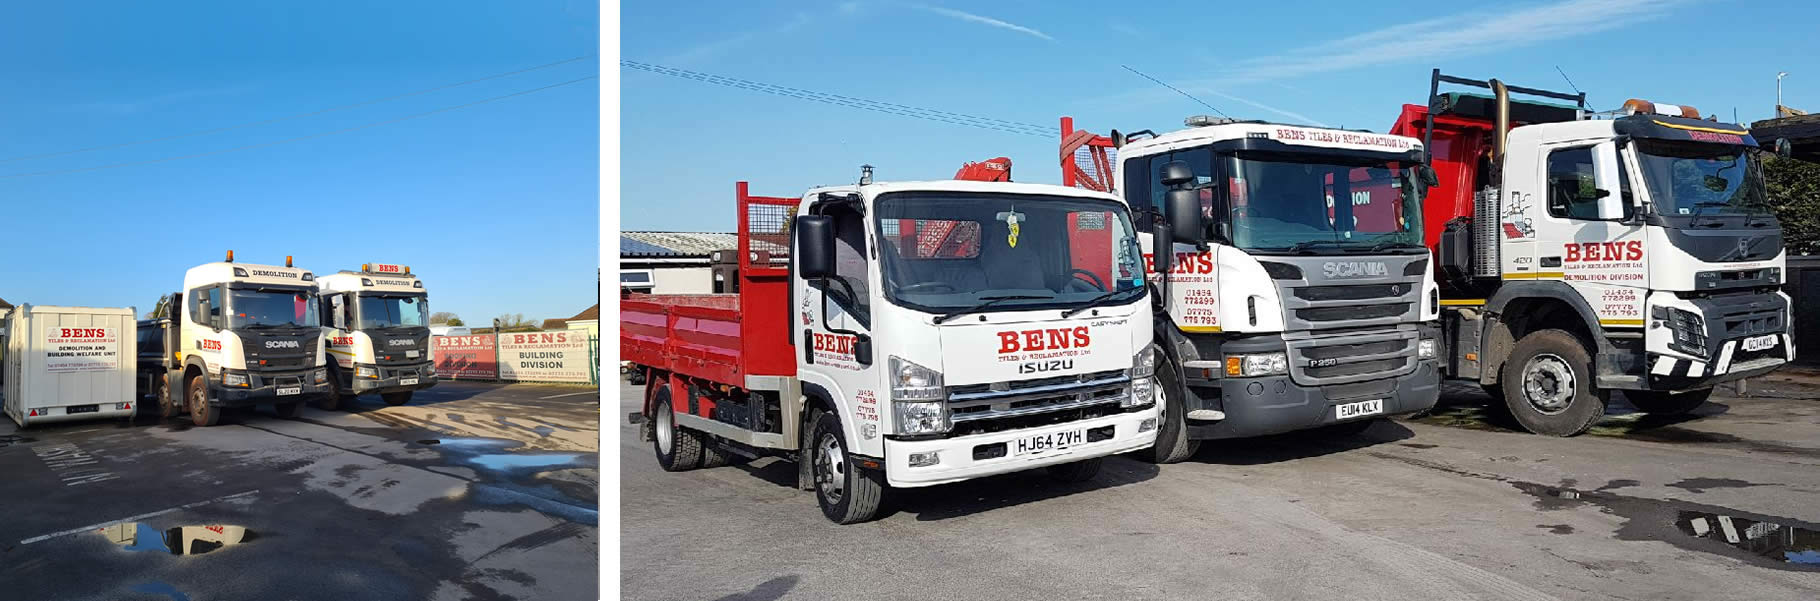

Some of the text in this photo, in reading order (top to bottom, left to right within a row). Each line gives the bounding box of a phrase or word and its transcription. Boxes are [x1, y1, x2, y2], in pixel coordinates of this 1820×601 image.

[1276, 129, 1305, 140] BENS
[1563, 240, 1643, 262] BENS
[378, 264, 399, 273] BENS
[1323, 261, 1389, 276] SCANIA
[252, 270, 297, 279] DEMOLITION
[1609, 273, 1644, 281] DIVISION
[1200, 316, 1217, 325] 793
[60, 328, 105, 338] BENS
[333, 336, 354, 345] BENS
[388, 338, 415, 346] SCANIA
[440, 336, 480, 346] BENS
[514, 333, 567, 344] BENS
[997, 325, 1090, 354] BENS
[203, 338, 222, 351] BENS
[265, 340, 300, 349] SCANIA
[519, 351, 564, 359] BUILDING
[520, 361, 563, 369] DIVISION
[1018, 359, 1074, 374] ISUZU
[1341, 400, 1379, 416] EU14 KLX
[1018, 429, 1082, 453] HJ64 ZVH
